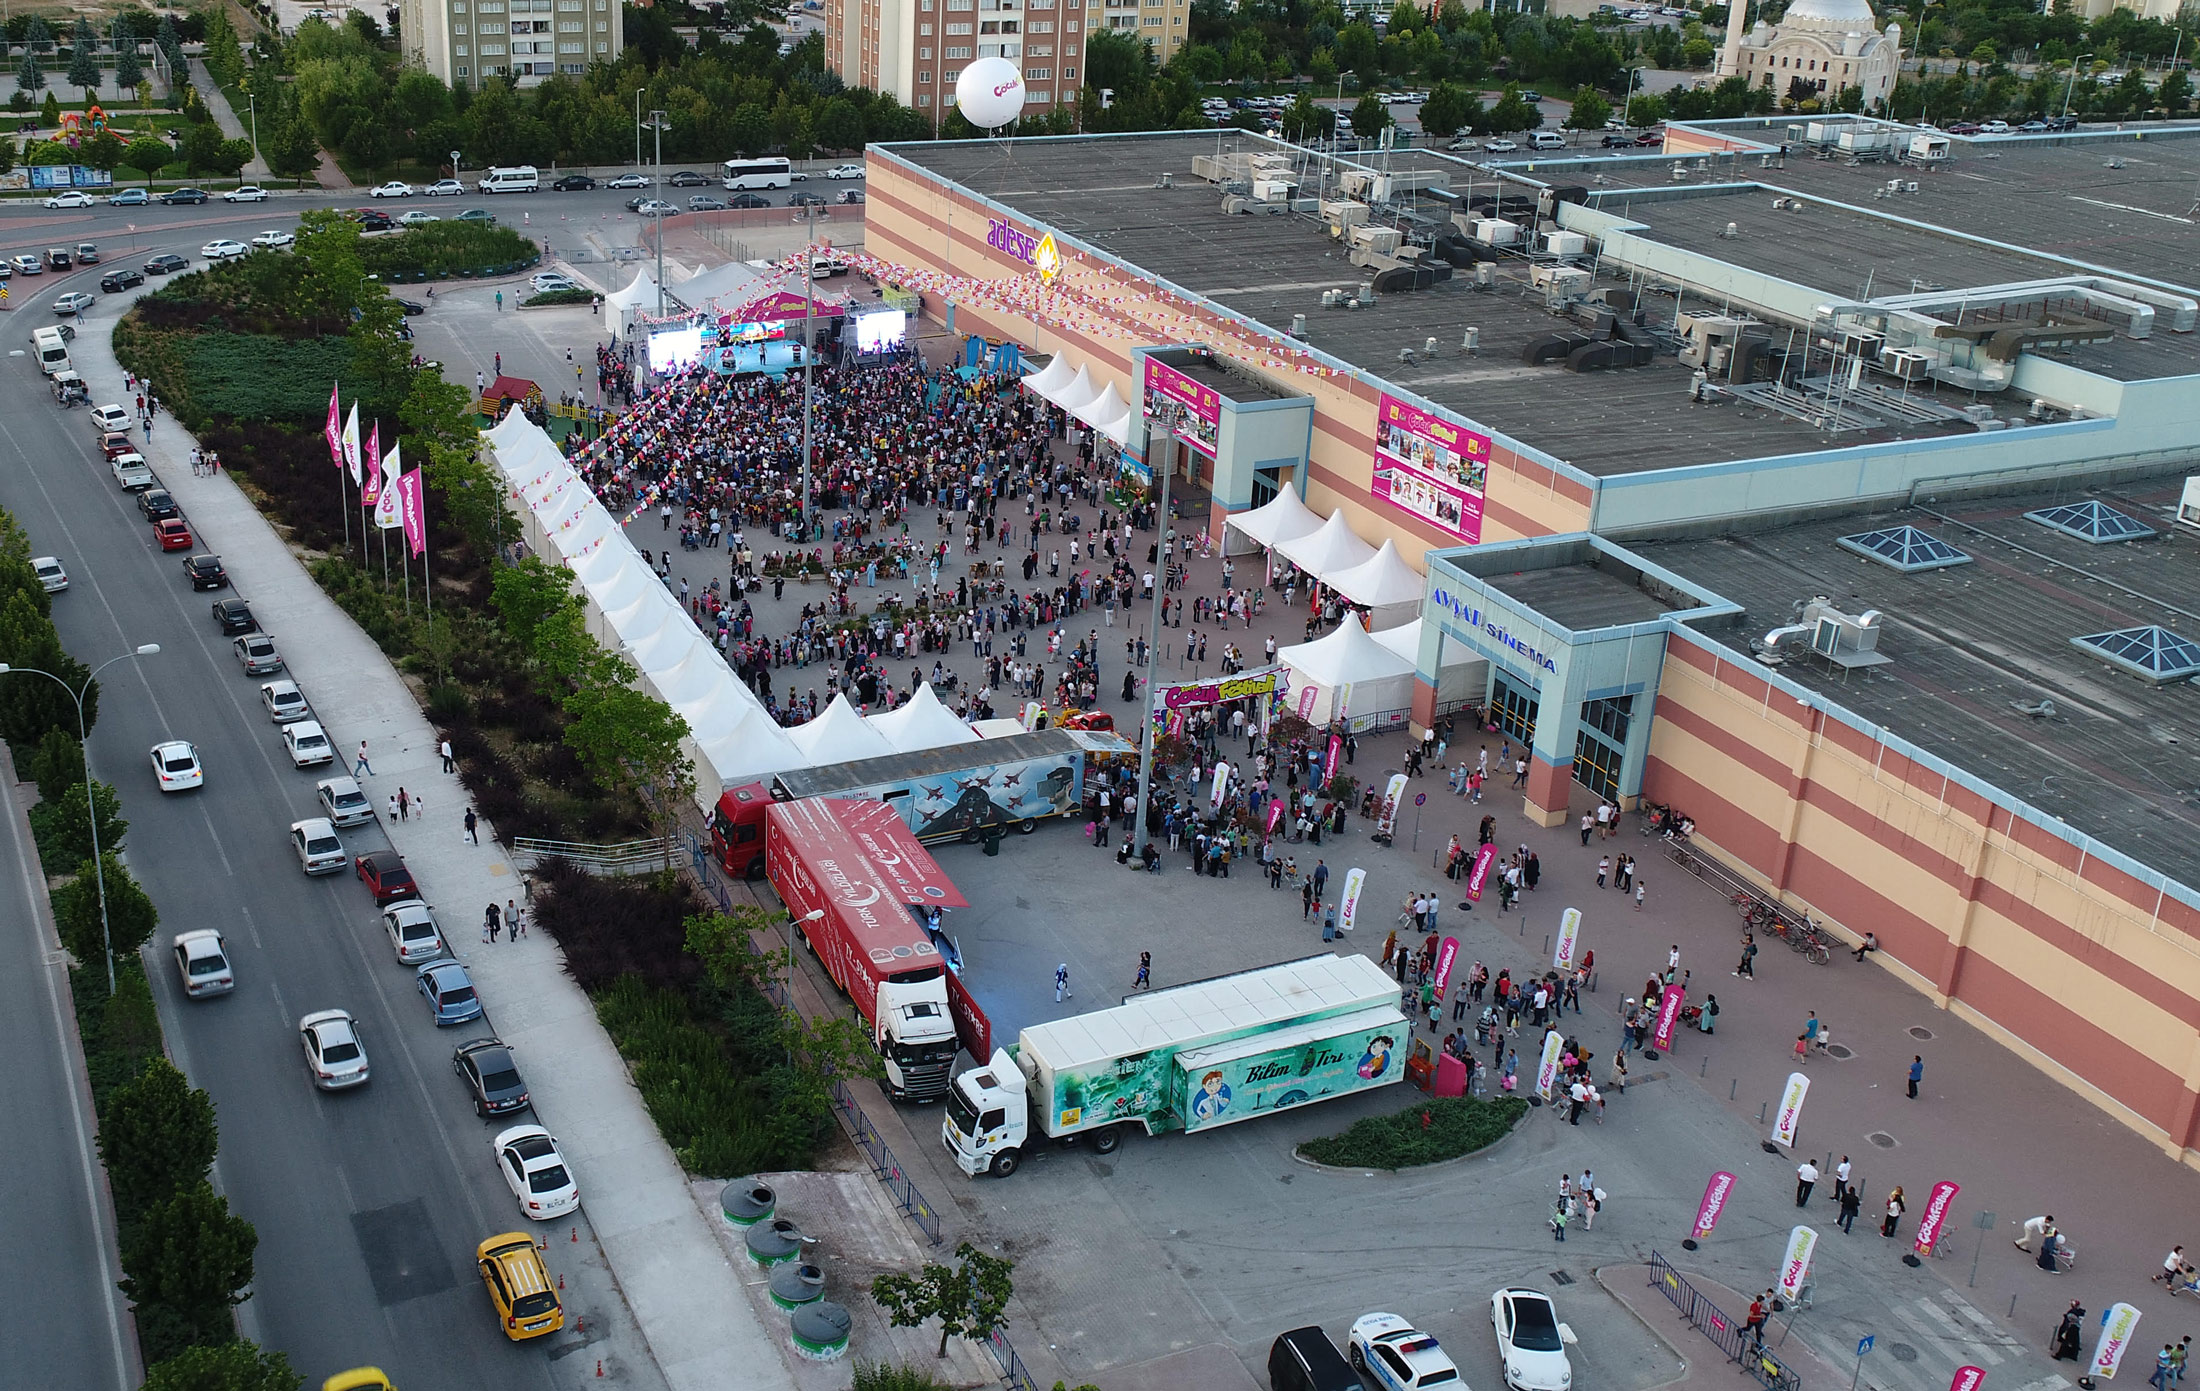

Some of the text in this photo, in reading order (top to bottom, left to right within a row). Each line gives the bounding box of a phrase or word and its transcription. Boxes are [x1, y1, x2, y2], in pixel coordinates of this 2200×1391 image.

[1219, 674, 1276, 700] Festivali
[824, 859, 880, 929] TÜRK YILDIZLARI
[1245, 1061, 1293, 1085] Bilim
